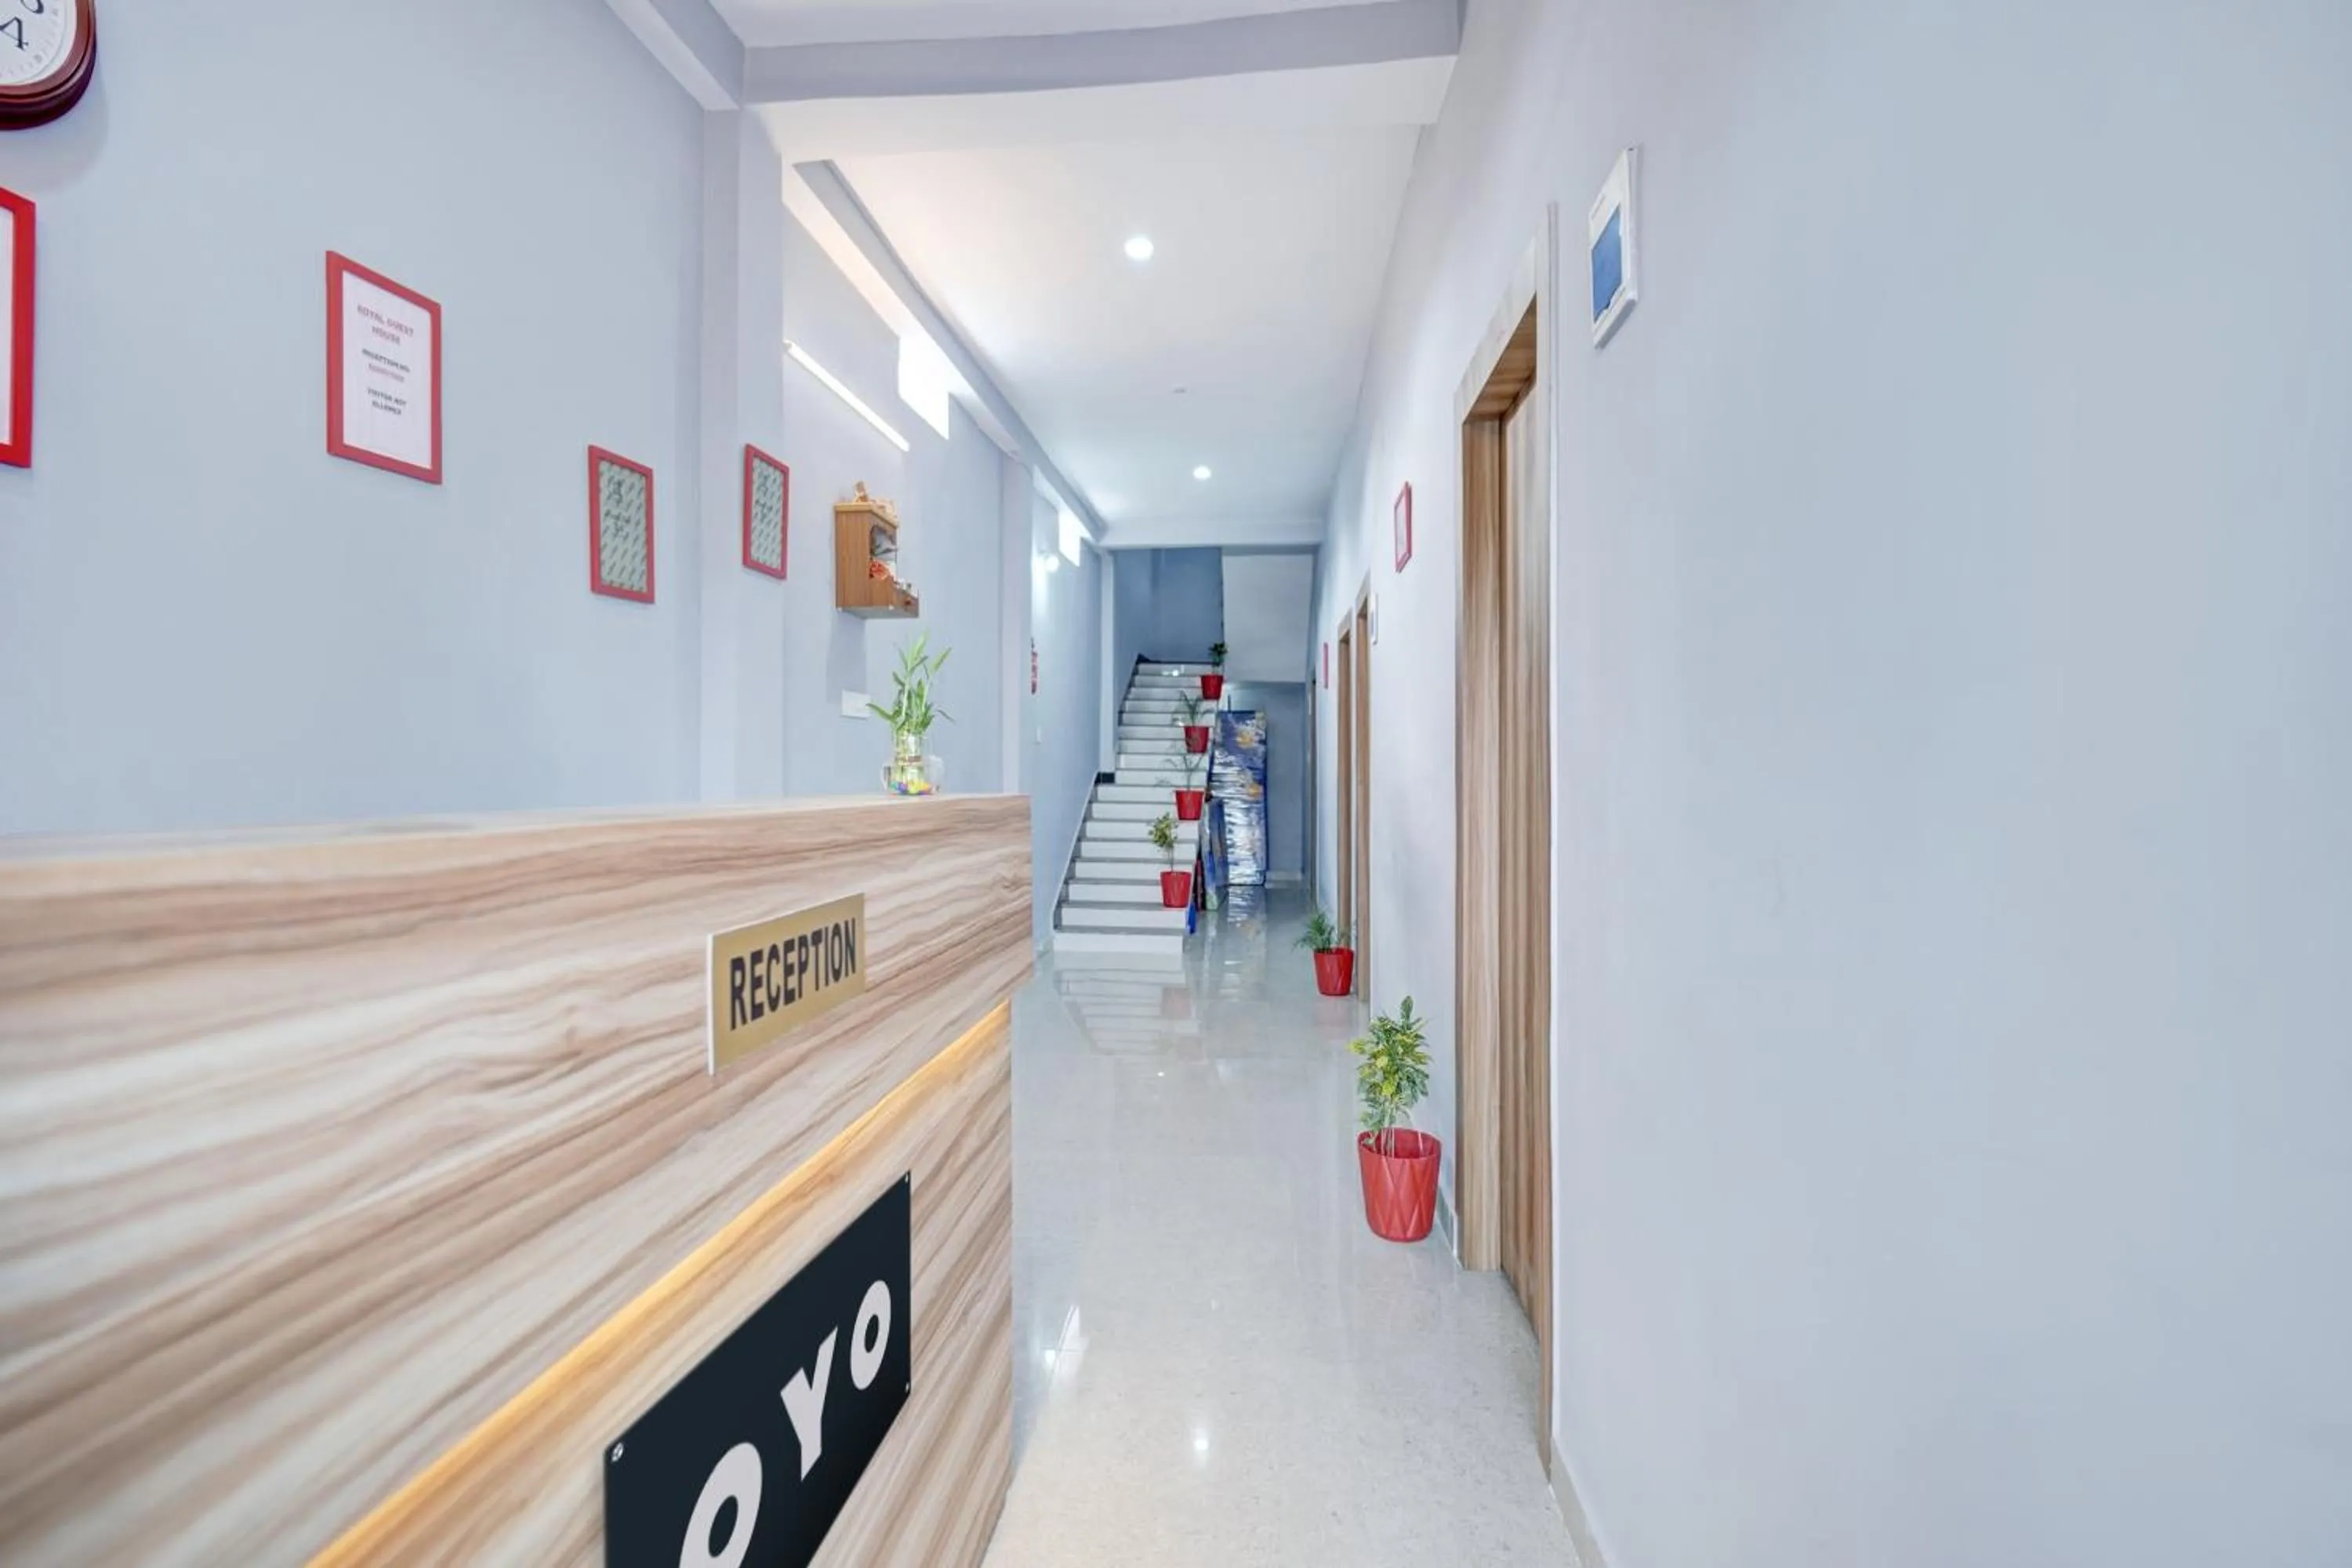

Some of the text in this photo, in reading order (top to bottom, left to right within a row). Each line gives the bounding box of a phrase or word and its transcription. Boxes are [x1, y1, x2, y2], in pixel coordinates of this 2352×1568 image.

[358, 303, 384, 325] ROYAL
[372, 325, 400, 345] HOUSE
[730, 917, 855, 1031] RECEPTION
[679, 1280, 891, 1568] OYO
